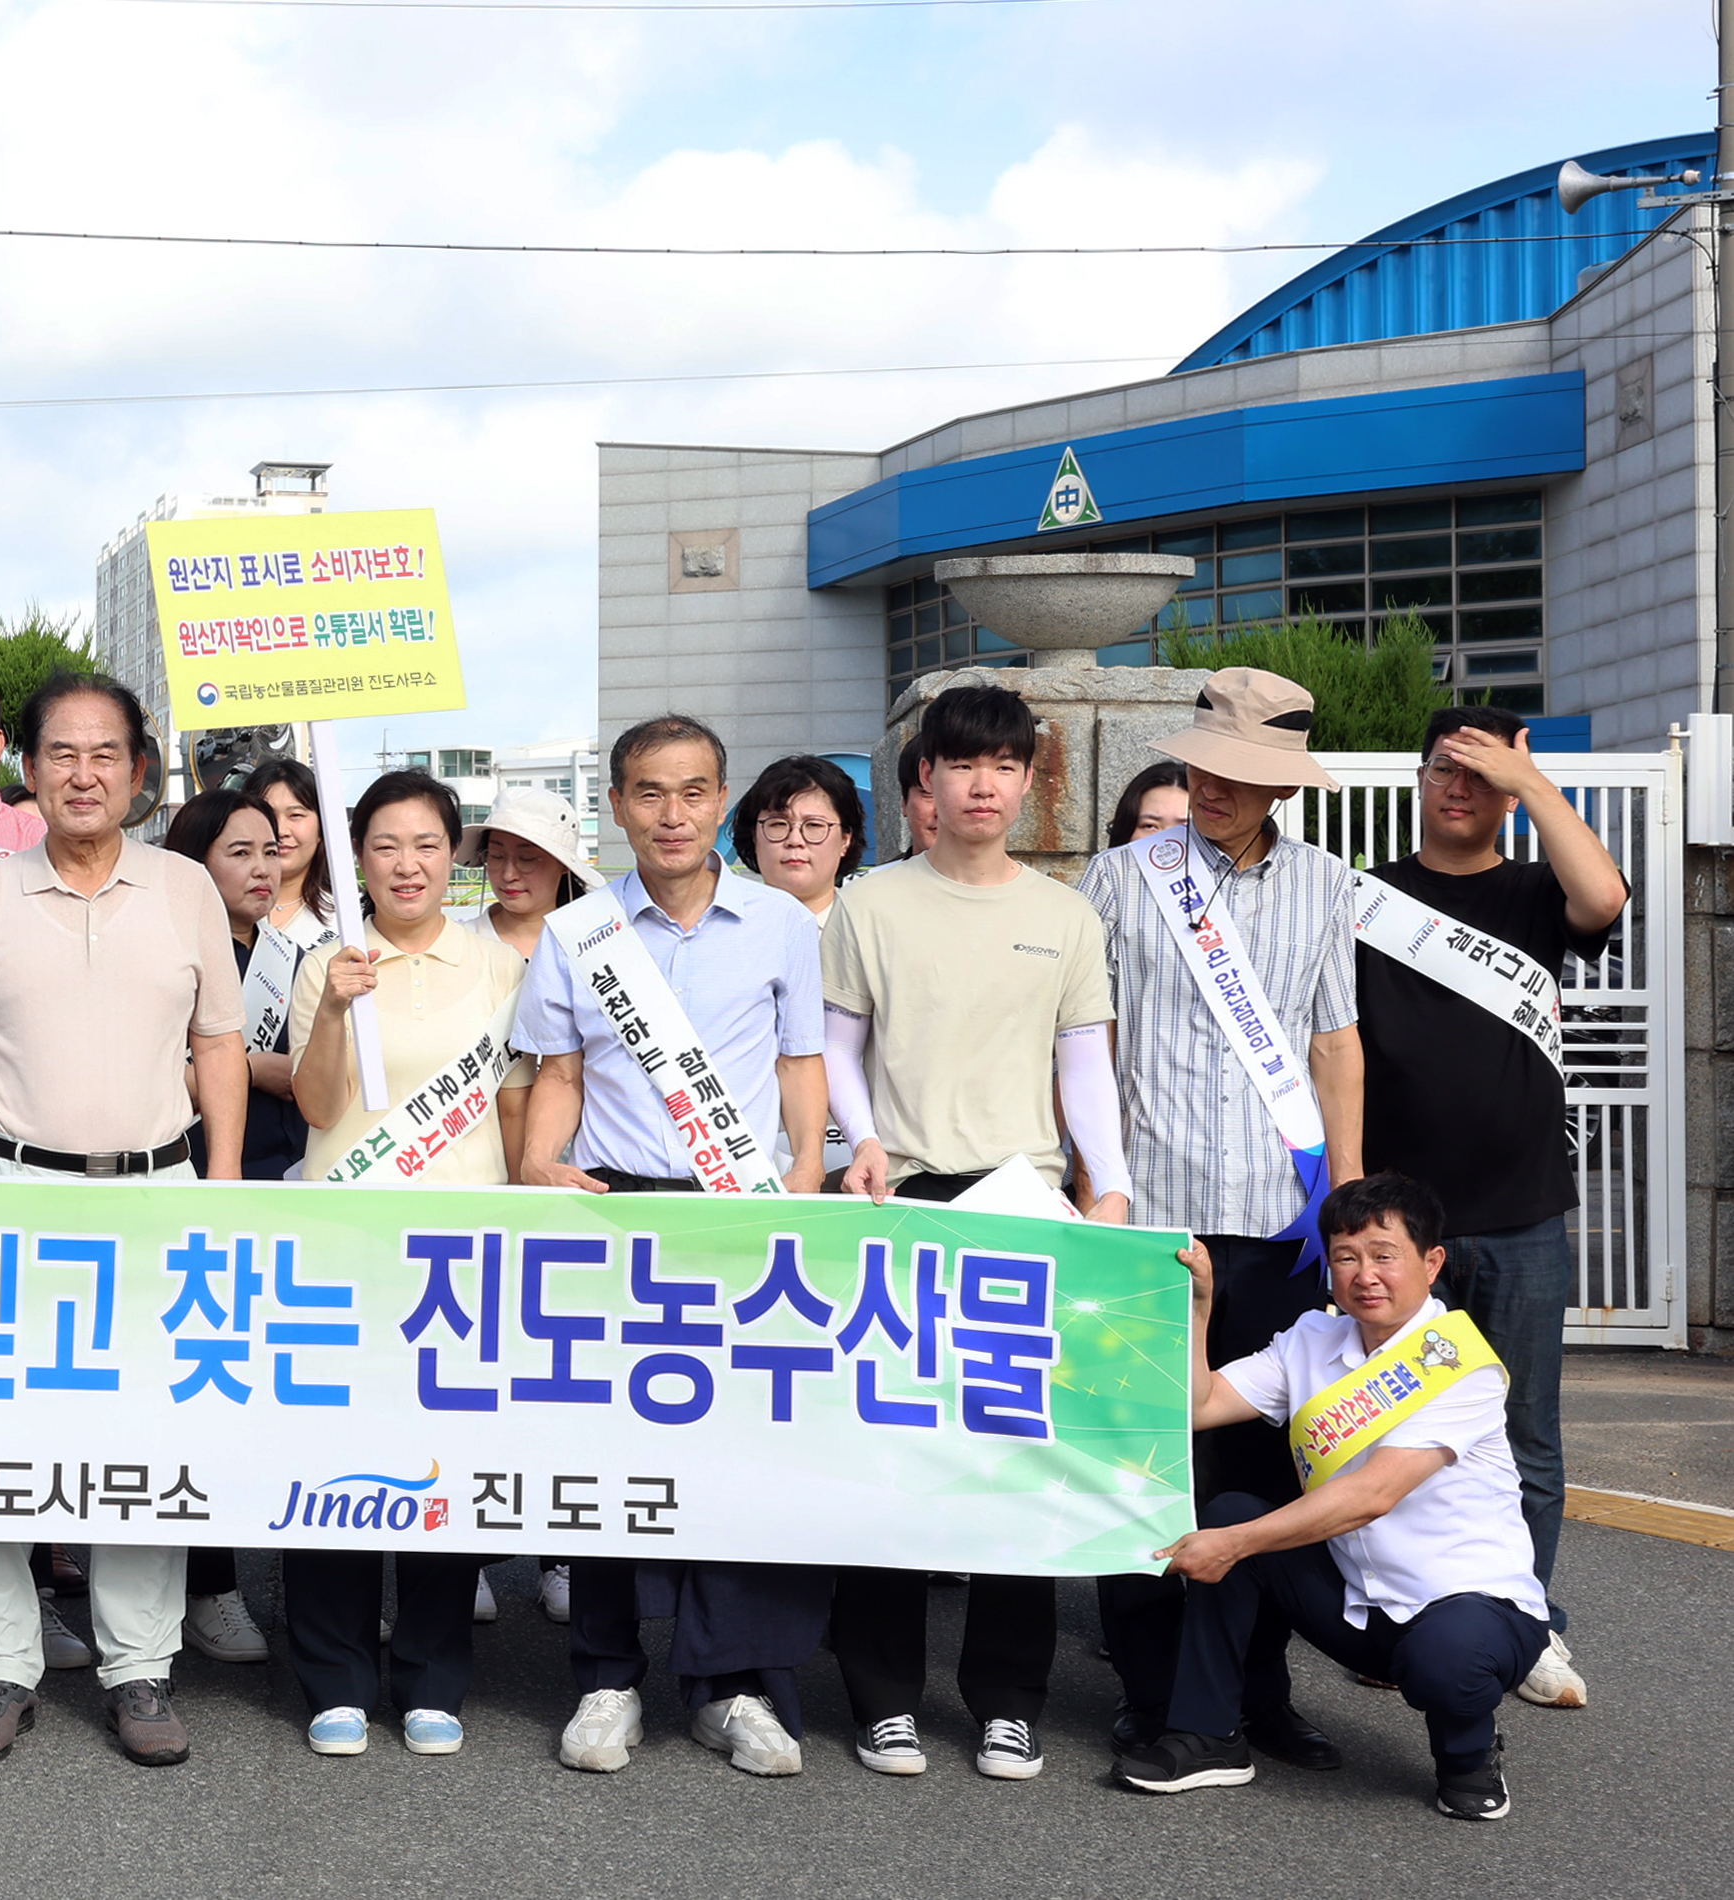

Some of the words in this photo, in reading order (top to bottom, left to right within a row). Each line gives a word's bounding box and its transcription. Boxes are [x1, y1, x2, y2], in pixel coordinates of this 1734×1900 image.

[168, 556, 234, 592] 원산지
[239, 552, 305, 588] 표시로
[310, 544, 425, 583] 소비자보호!
[178, 614, 309, 657] 원산지확인으로
[313, 610, 386, 649] 유통질서
[388, 608, 435, 643] 확립!
[223, 676, 364, 701] 국립농산물품질관리원
[367, 671, 438, 691] 진도사무소
[576, 924, 615, 958] Jindo
[1445, 927, 1547, 998] 살맛나는
[591, 963, 668, 1076] 실천하는
[395, 1085, 489, 1178] 전통시장
[675, 1046, 757, 1162] 함께하는
[159, 1231, 360, 1406] 찾는
[398, 1232, 1059, 1440] 진도농수산물
[267, 1478, 419, 1533] Jindo
